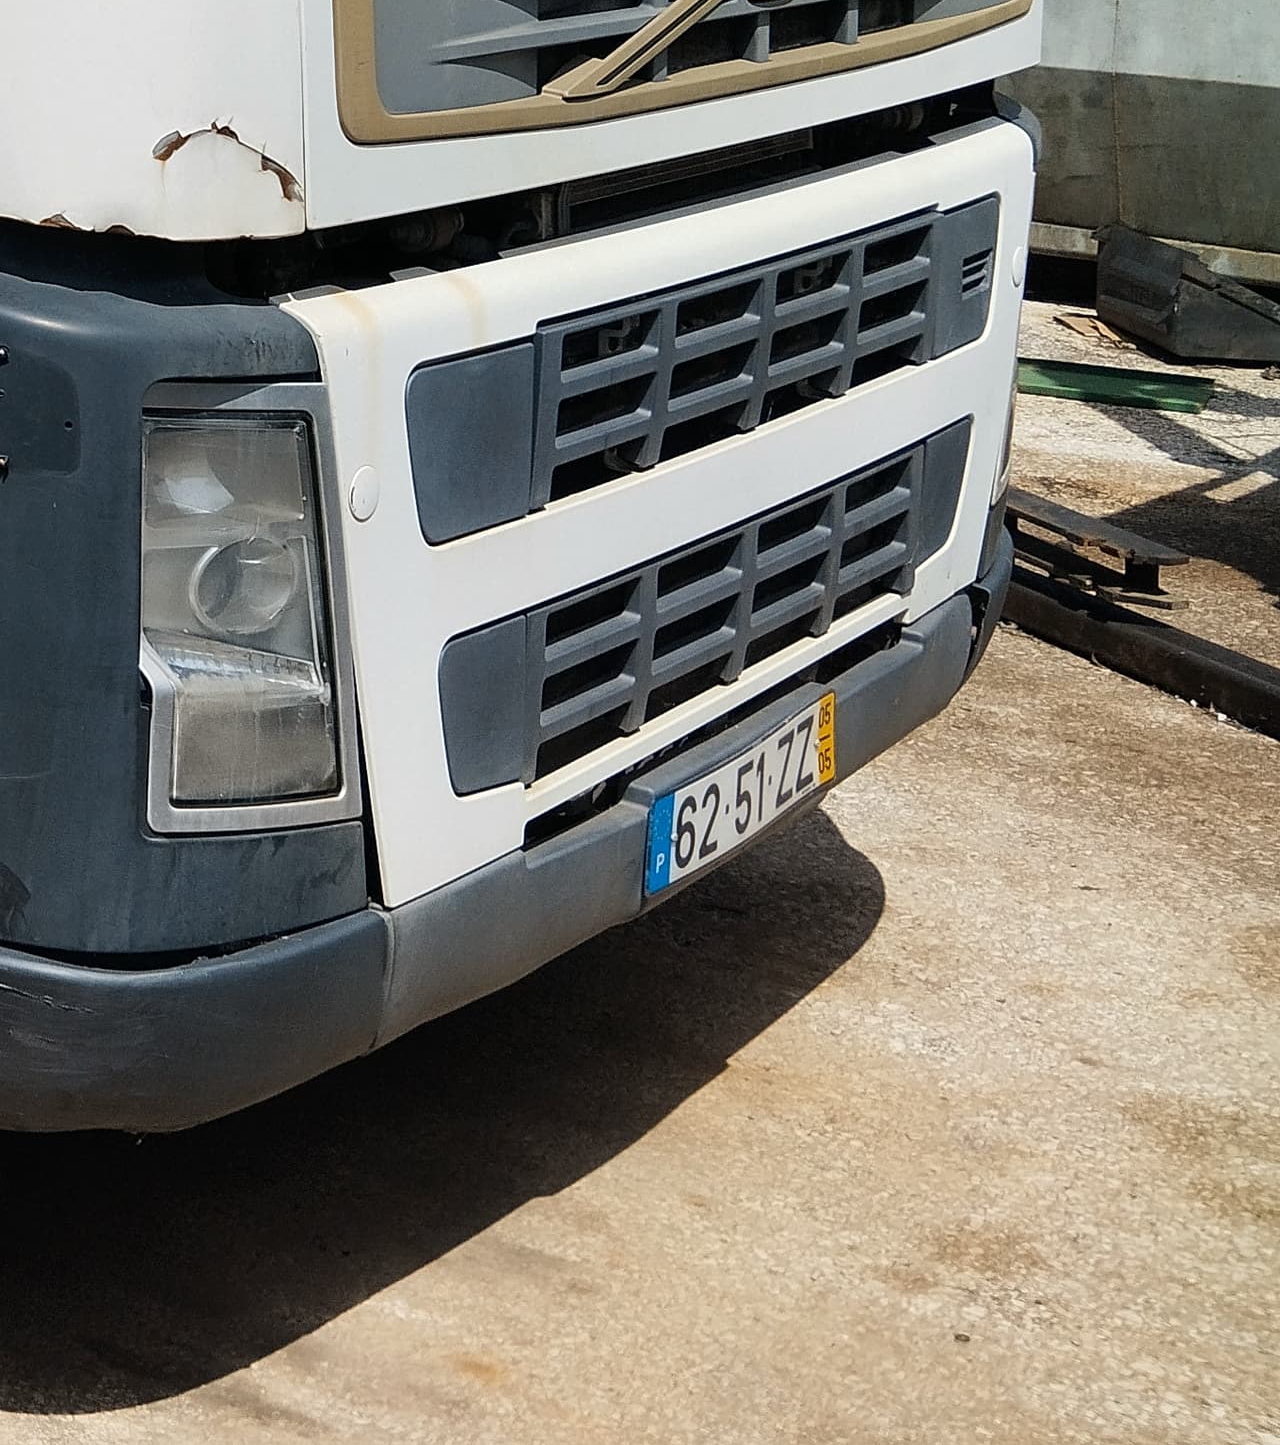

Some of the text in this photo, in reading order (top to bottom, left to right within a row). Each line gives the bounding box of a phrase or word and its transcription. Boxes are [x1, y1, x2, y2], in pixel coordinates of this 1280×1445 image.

[818, 702, 832, 728] 05
[818, 747, 832, 774] 05
[655, 852, 666, 874] P
